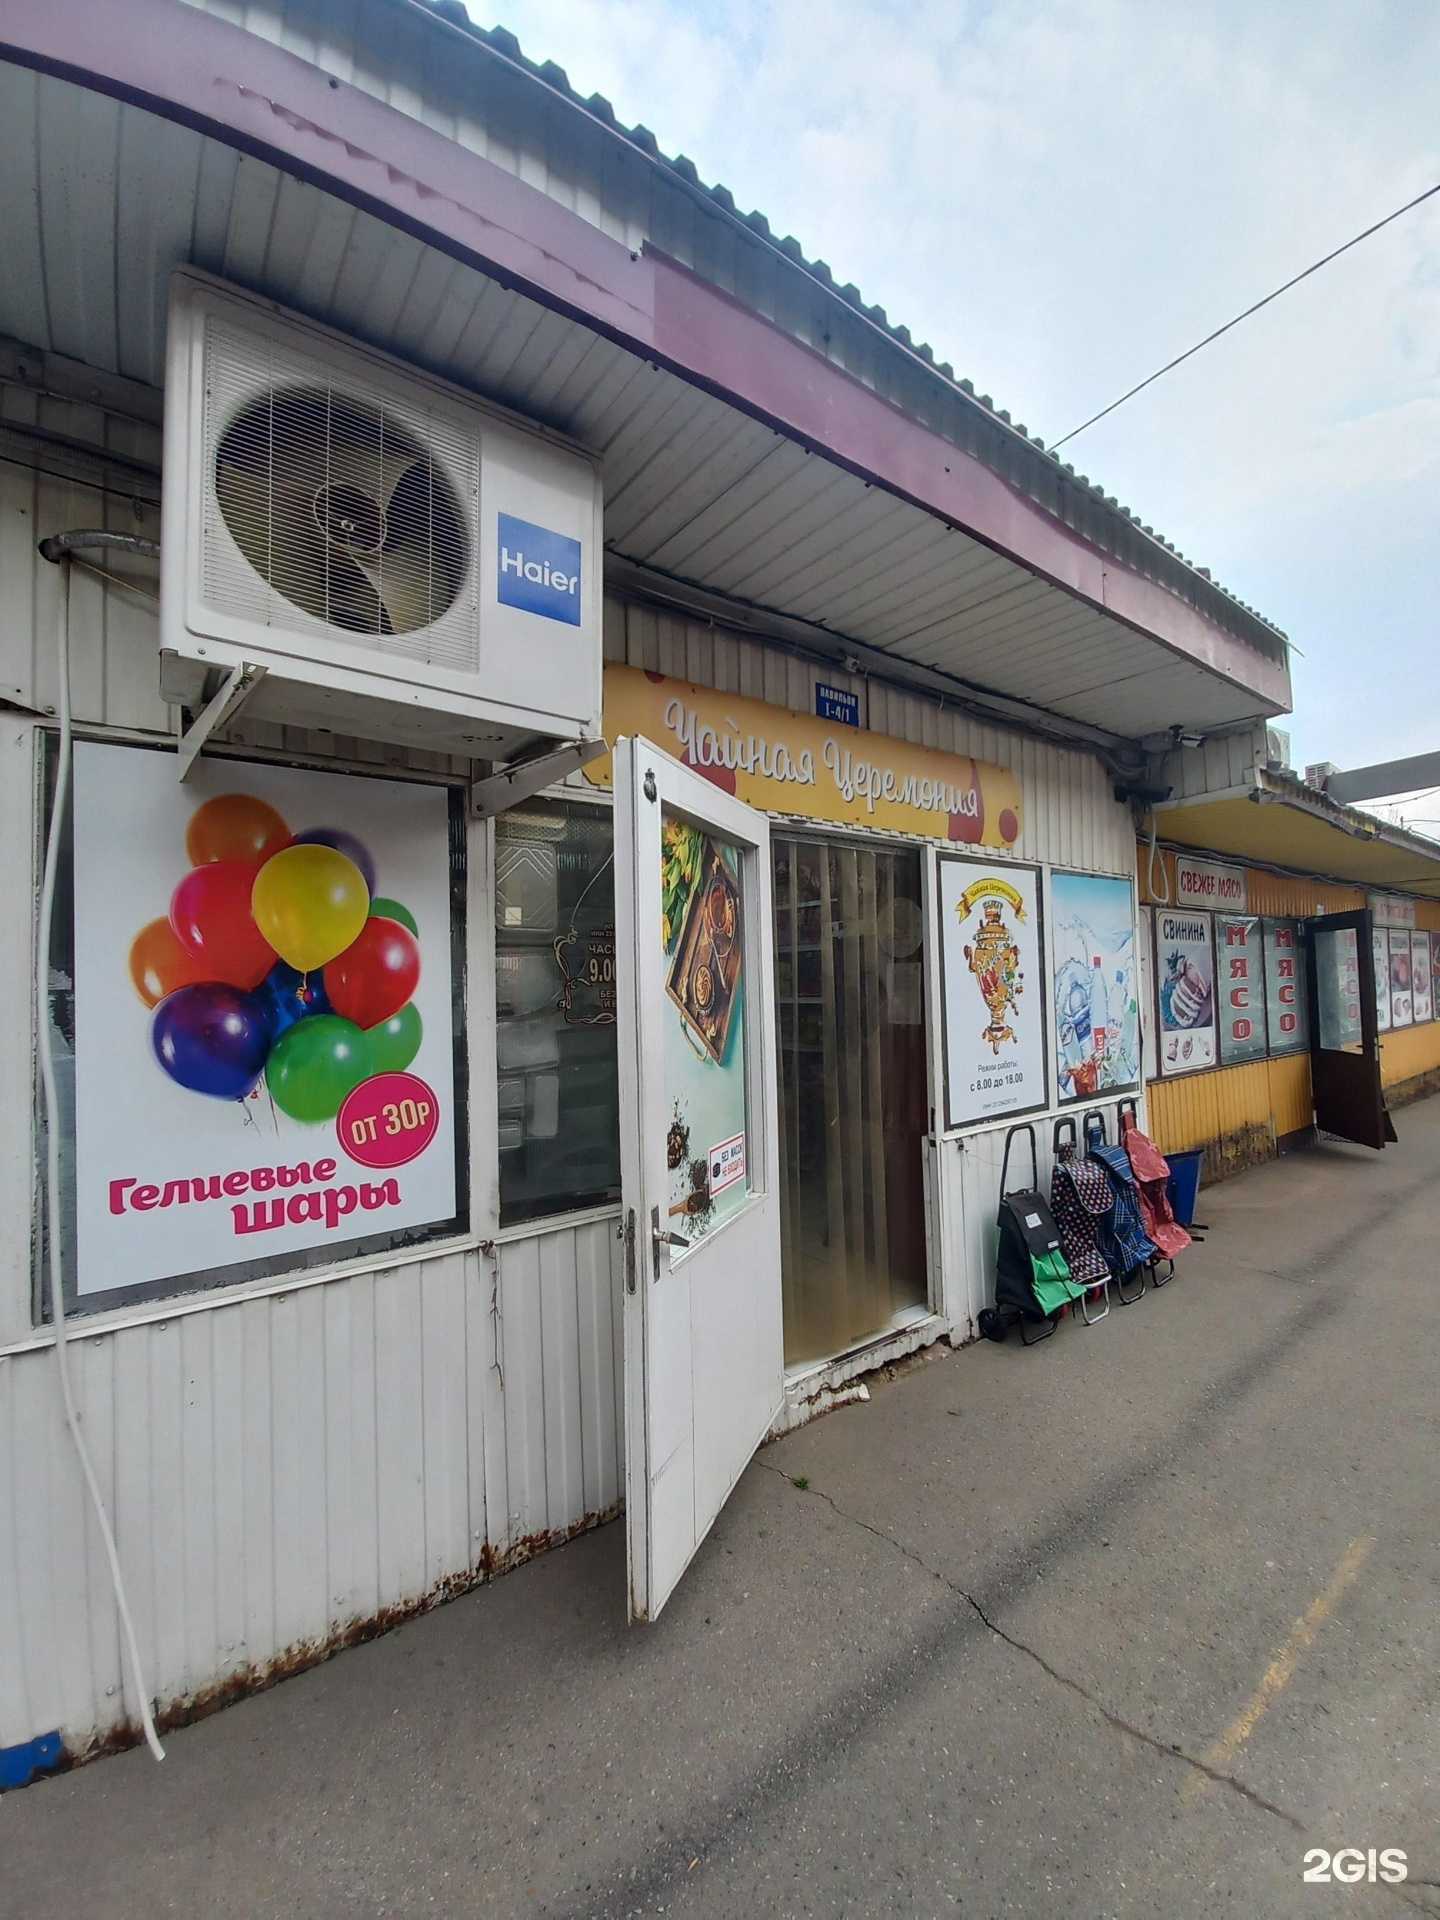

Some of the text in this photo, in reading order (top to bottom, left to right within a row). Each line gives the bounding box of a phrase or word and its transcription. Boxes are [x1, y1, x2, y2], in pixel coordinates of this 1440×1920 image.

[502, 546, 578, 595] Haier
[665, 697, 978, 817] Чайная Церемония
[1181, 871, 1241, 898] СВЕЖЕЕ МЯСО
[1163, 919, 1205, 943] СВИНИНА
[1225, 925, 1252, 1041] МЯСО
[1275, 928, 1297, 1033] МЯСО
[993, 1078, 1004, 1088] до
[108, 1157, 337, 1216] Гелиевые
[230, 1178, 402, 1235] шары
